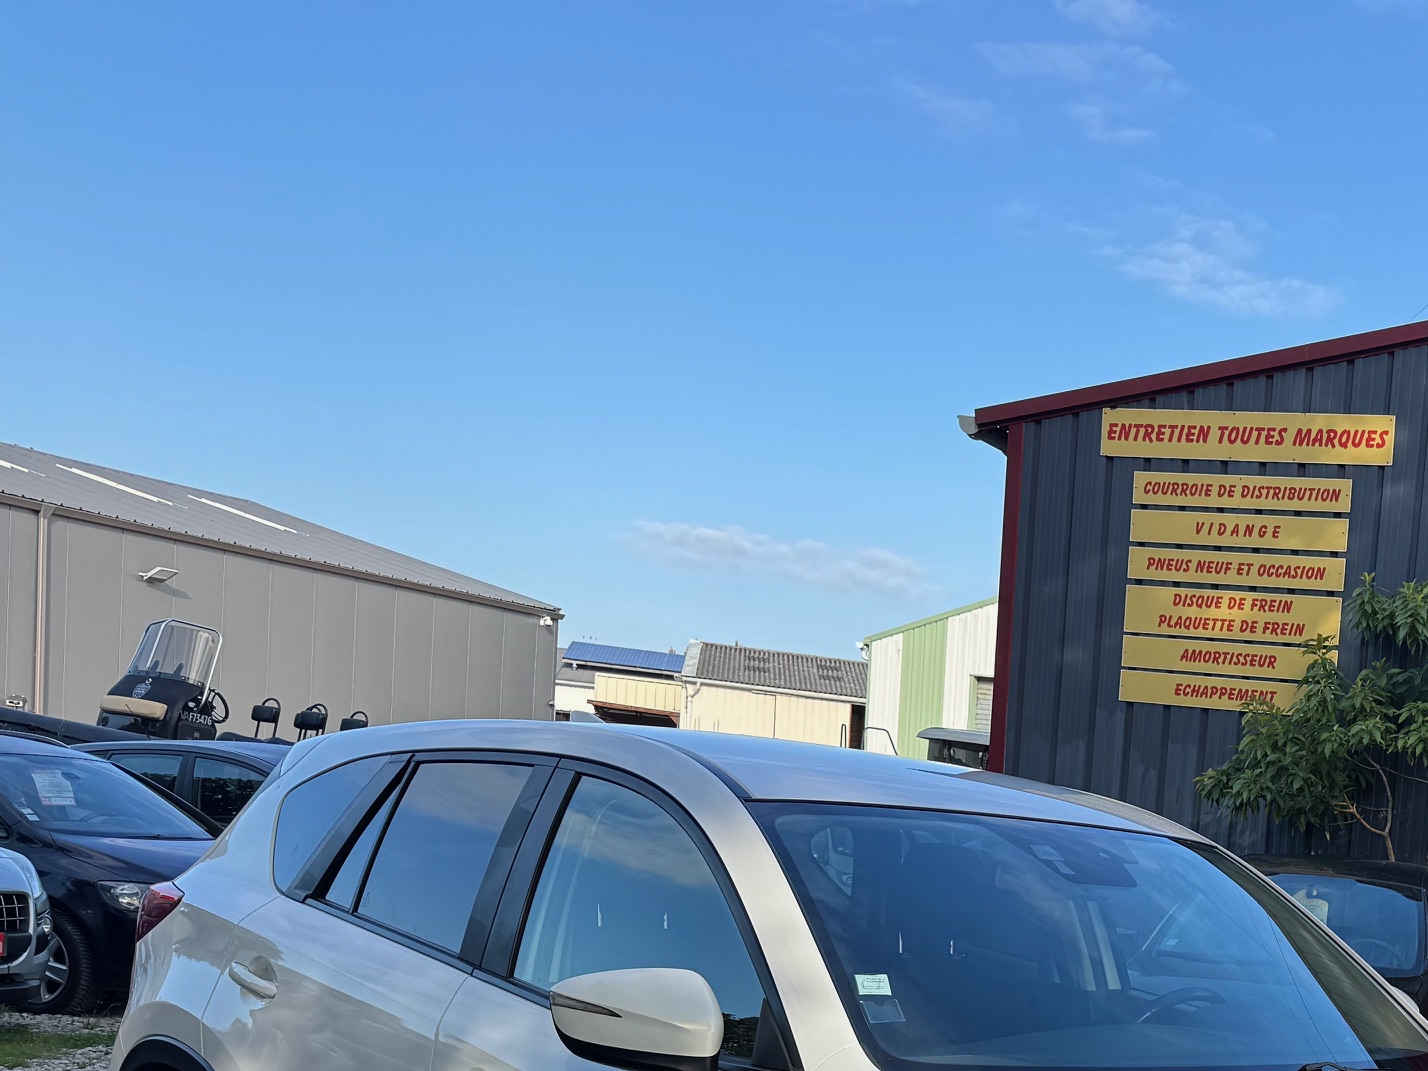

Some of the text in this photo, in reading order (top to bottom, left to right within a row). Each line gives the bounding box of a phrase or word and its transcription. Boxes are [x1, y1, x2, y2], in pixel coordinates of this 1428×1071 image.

[1107, 422, 1390, 450] ENTRETIEN TOUTES MARQUES
[1143, 481, 1342, 503] COURROIE DE DISTRIBUTION
[1195, 521, 1281, 539] VIDANGE
[1146, 557, 1326, 581] PNEUS NEUF ET OCCASION
[1172, 593, 1293, 614] DISQUE DE FREIN
[1158, 614, 1305, 637] PLAQUETTE DE FREIN
[1180, 648, 1278, 670] AMORTISSEUR
[1174, 683, 1278, 702] ECHAPPEMENT
